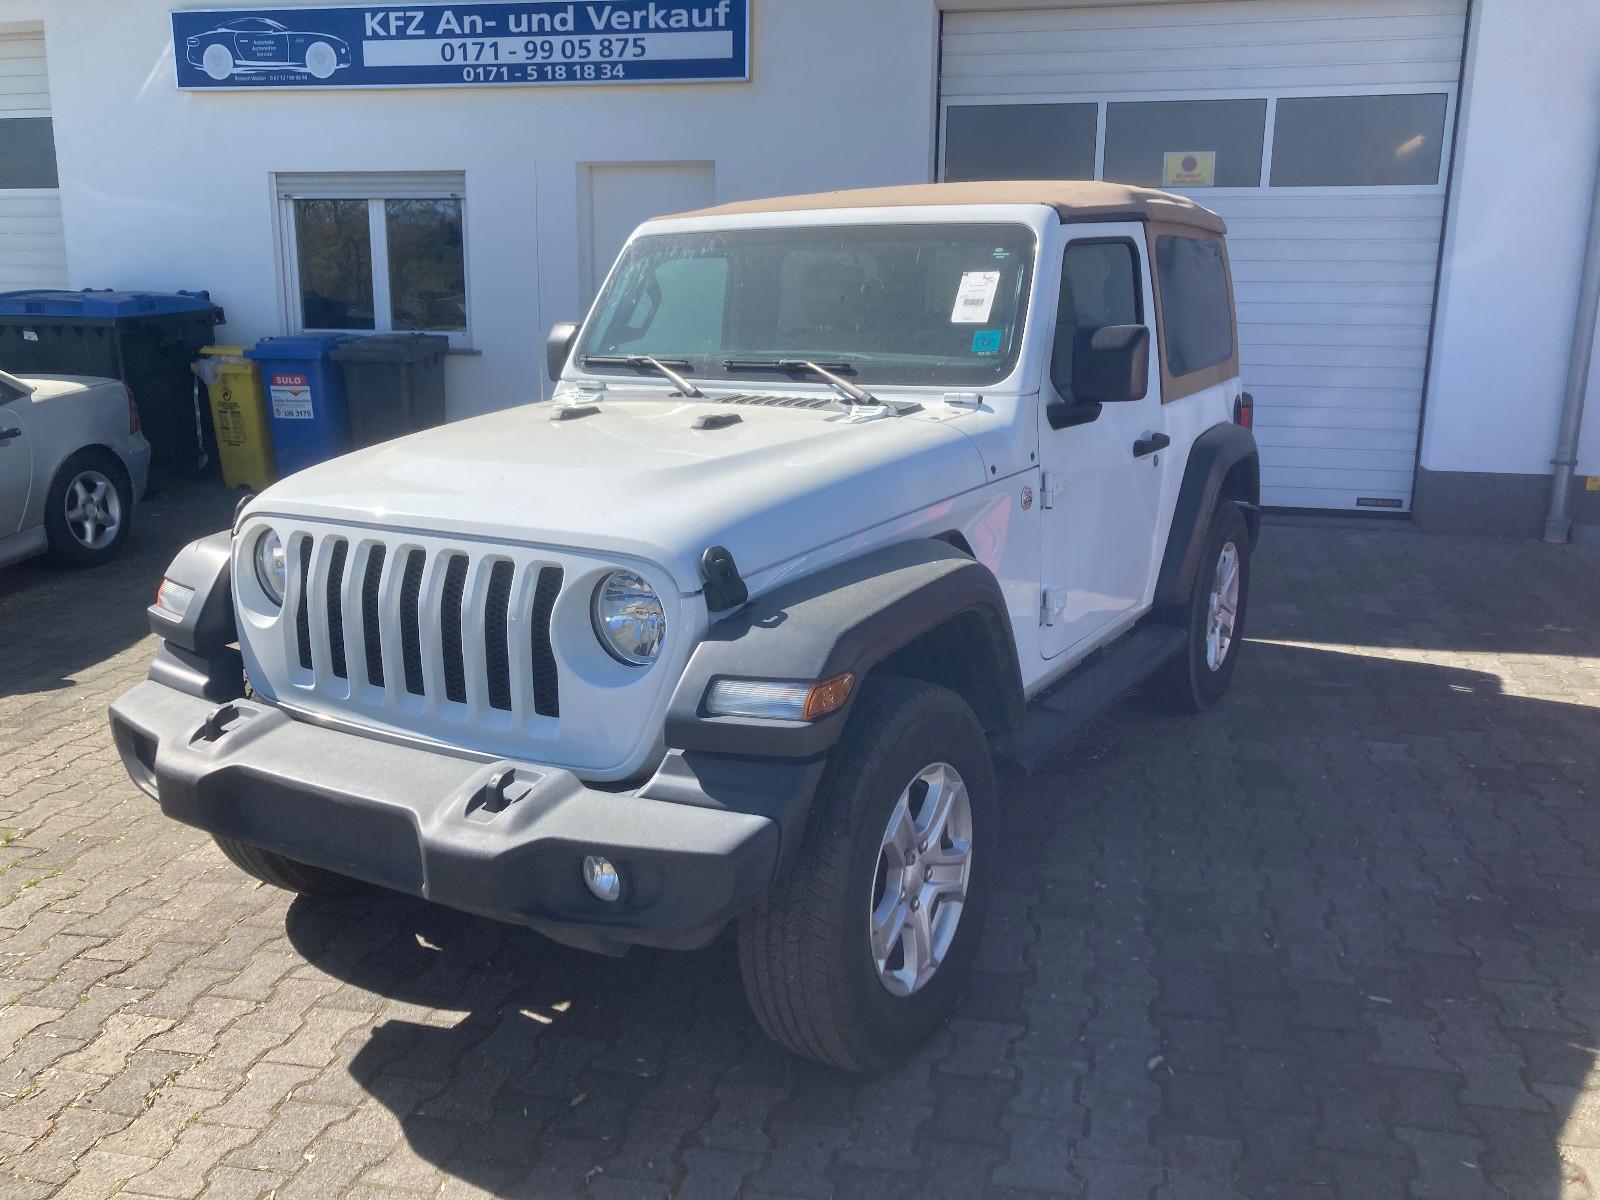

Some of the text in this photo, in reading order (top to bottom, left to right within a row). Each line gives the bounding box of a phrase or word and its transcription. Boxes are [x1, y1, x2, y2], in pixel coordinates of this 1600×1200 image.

[364, 0, 731, 37] KFZ An- und Verkauf
[440, 41, 500, 63] 0171
[523, 40, 554, 61] 99
[561, 38, 592, 60] 05
[599, 37, 647, 59] 875
[462, 66, 509, 82] 0171
[600, 63, 626, 79] 34
[275, 376, 302, 385] SULO
